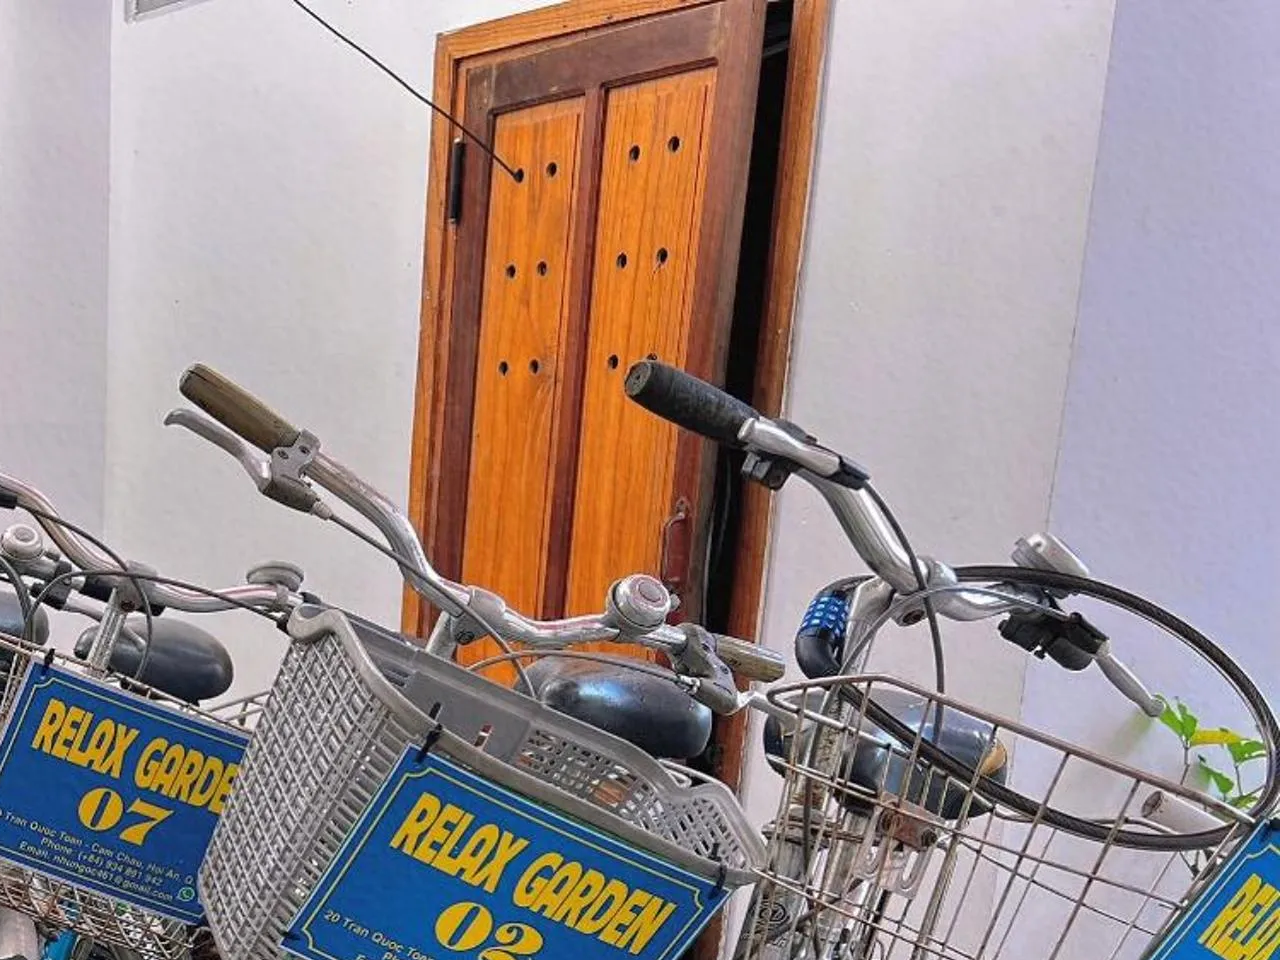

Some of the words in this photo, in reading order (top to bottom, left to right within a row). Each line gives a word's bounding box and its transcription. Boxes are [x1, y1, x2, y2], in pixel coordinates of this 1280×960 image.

[32, 699, 139, 779] RELAX
[135, 737, 240, 815] GARDE
[30, 821, 57, 836] Quoc
[60, 831, 82, 845] Toan
[78, 787, 174, 845] 07
[389, 792, 529, 893] RELAX
[512, 852, 677, 955] GARDEN
[324, 910, 340, 923] 20
[342, 917, 369, 938] Tran
[371, 932, 404, 953] Quoc
